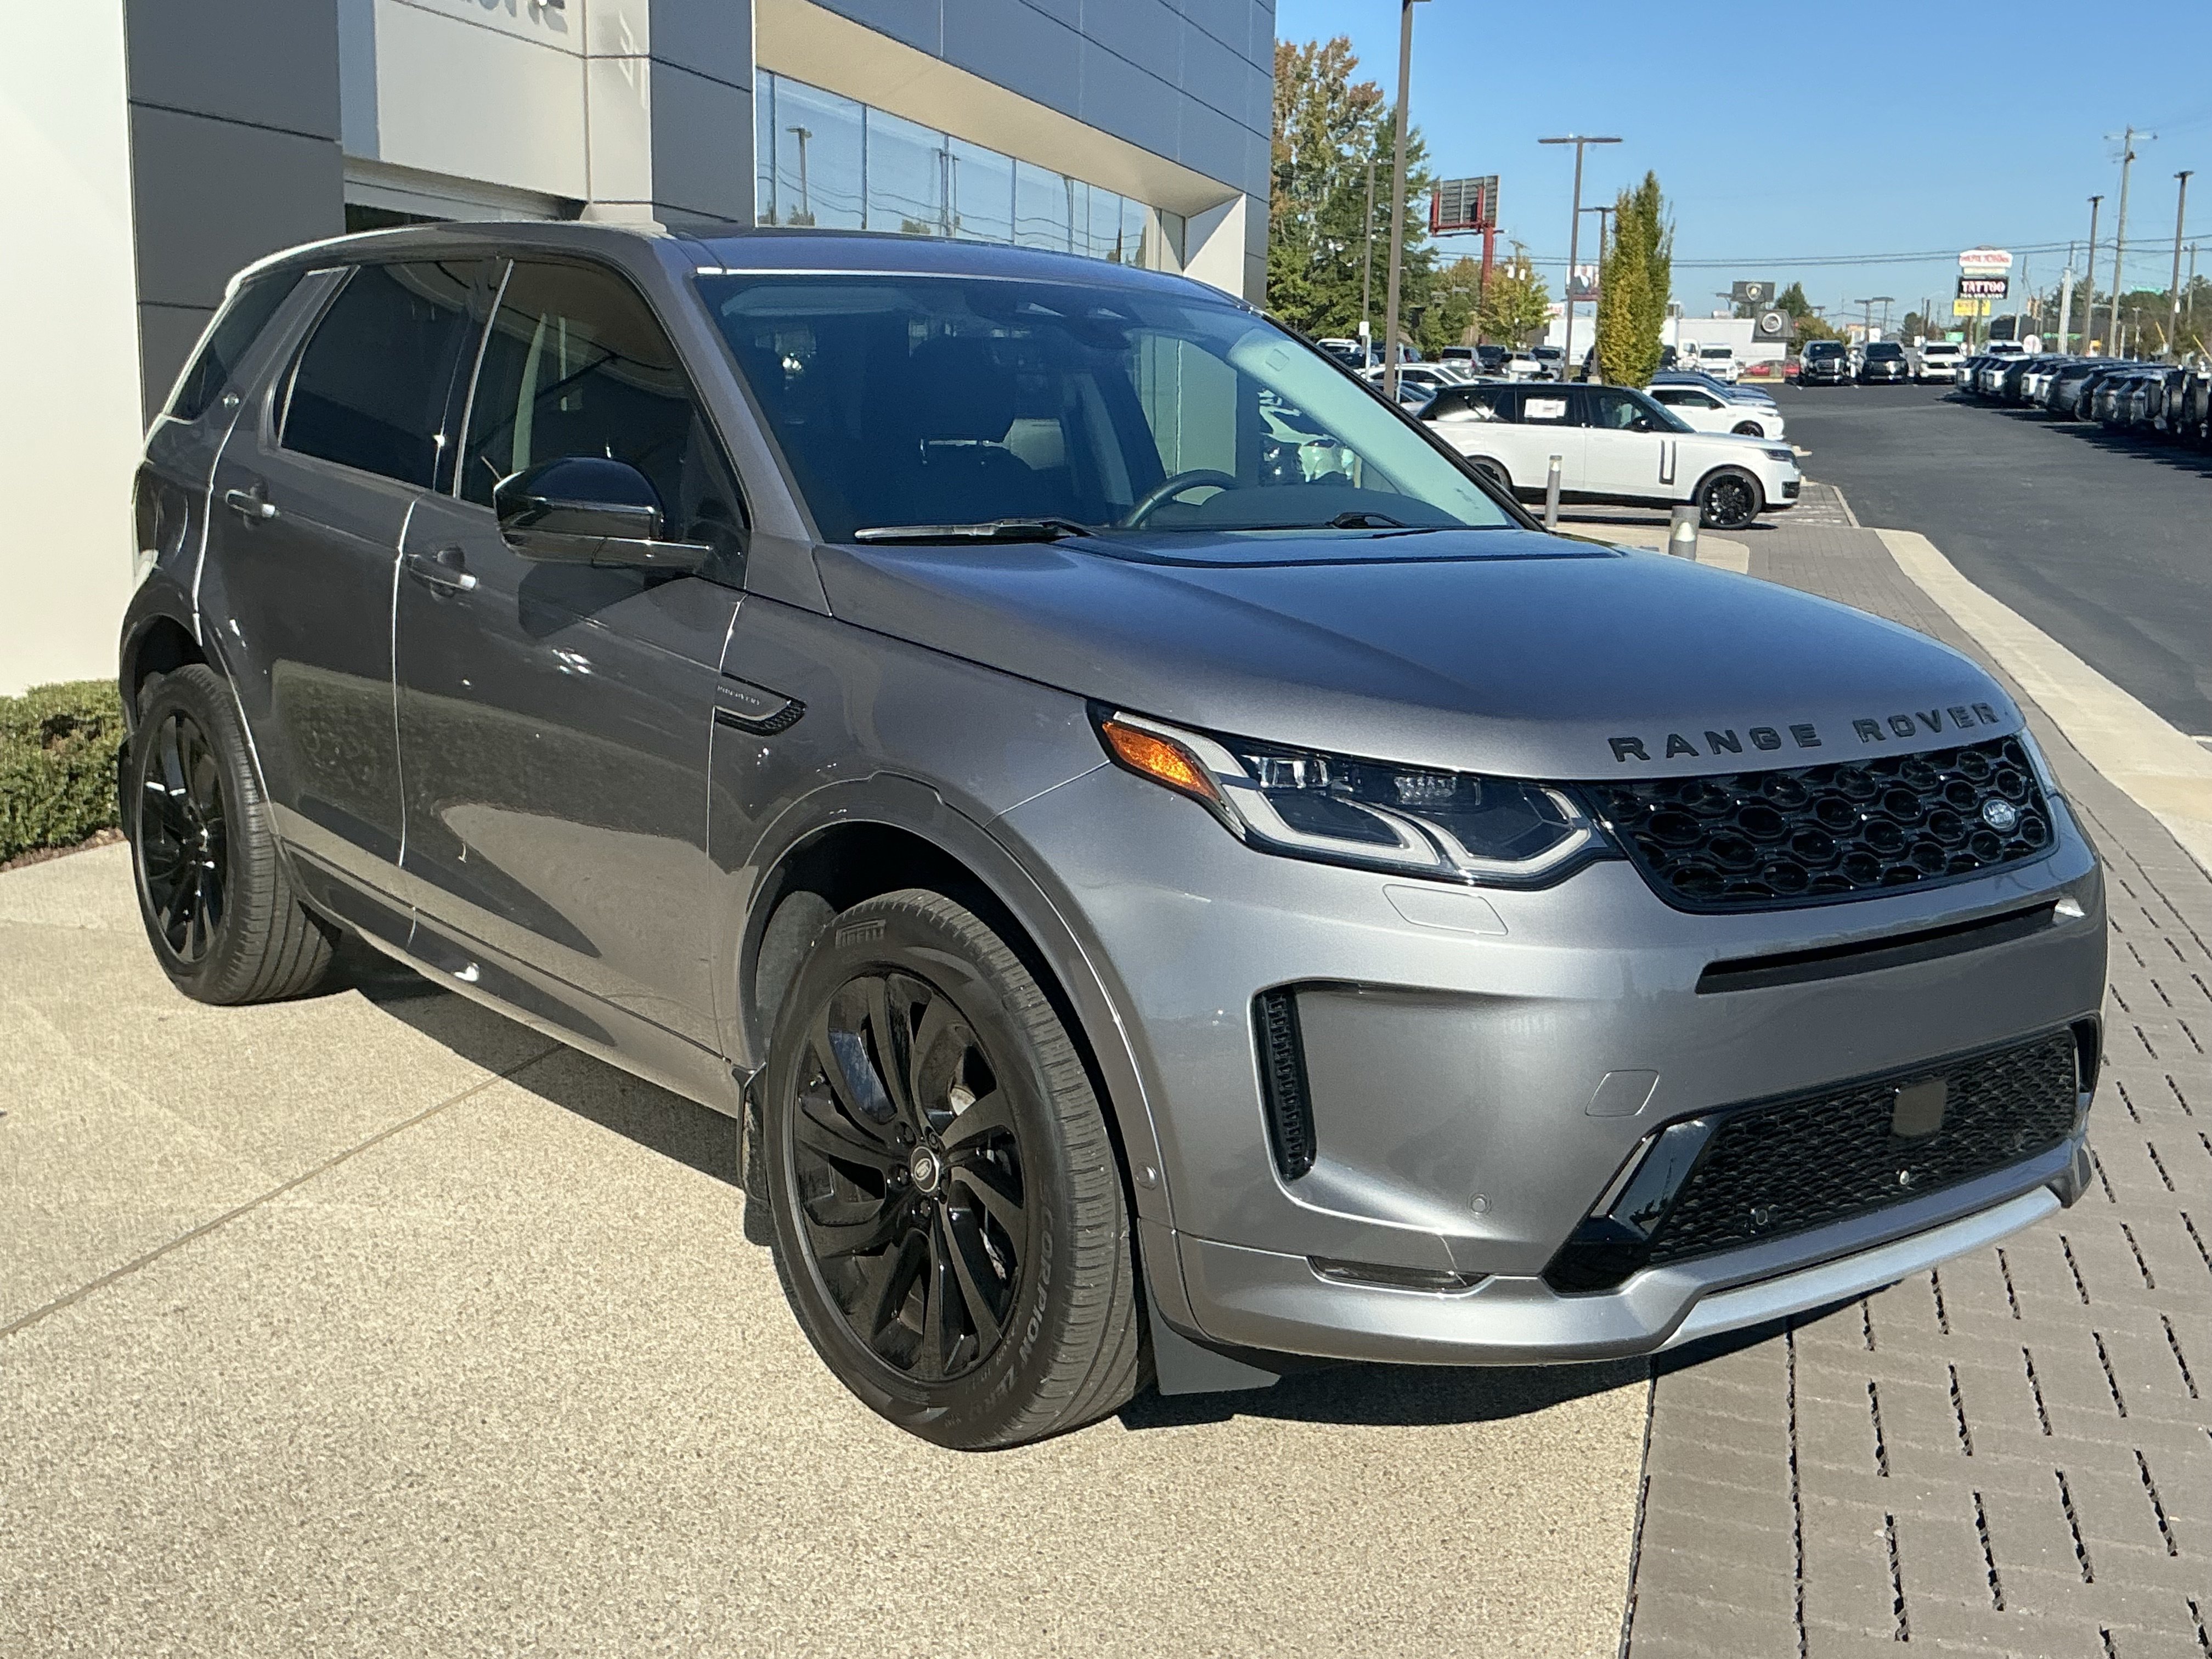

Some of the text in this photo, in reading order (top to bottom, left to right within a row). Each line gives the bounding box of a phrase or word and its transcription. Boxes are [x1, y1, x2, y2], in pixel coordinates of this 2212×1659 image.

[1961, 280, 2006, 293] TATTOO
[1608, 702, 2000, 763] RANGE ROVER
[835, 919, 887, 949] PIRELLI
[1019, 1193, 1053, 1365] CORPION
